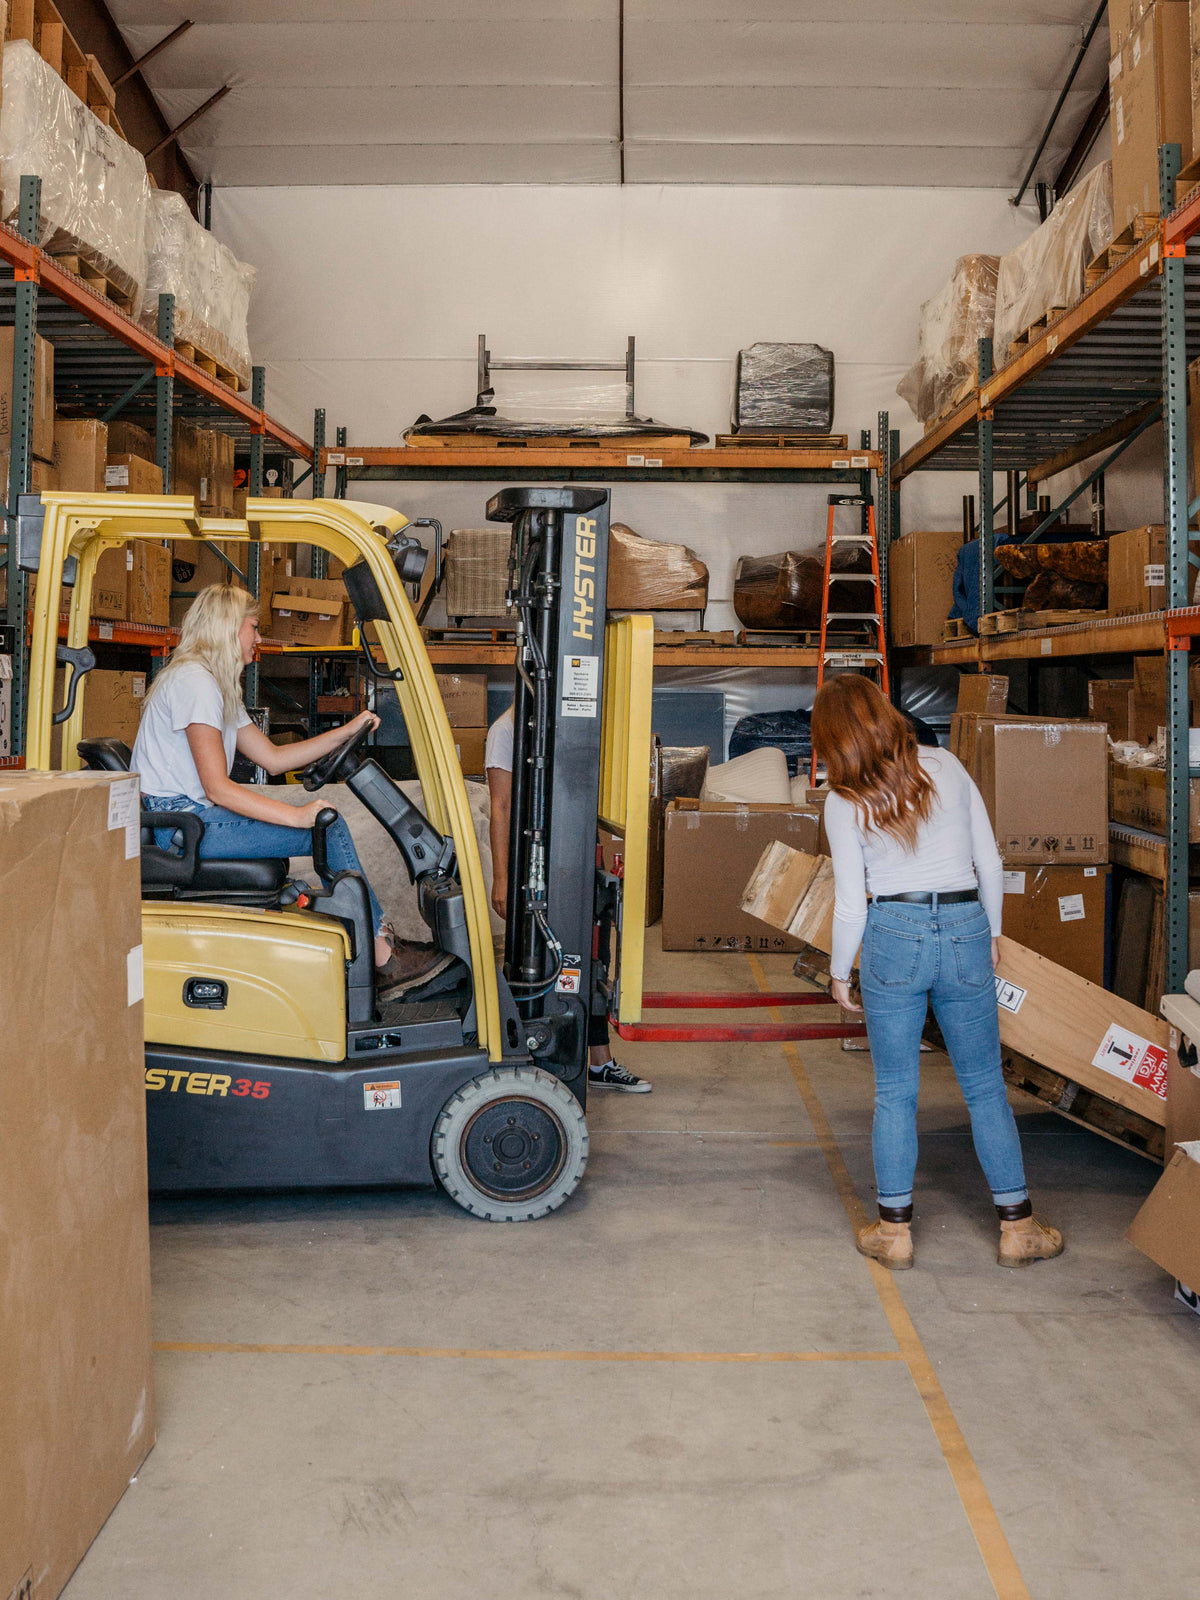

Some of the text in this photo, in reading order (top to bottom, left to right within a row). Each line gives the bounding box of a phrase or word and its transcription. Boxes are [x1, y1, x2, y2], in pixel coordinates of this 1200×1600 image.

[572, 516, 597, 640] HYSTER
[1066, 836, 1072, 845] 4
[745, 935, 751, 945] 3
[1140, 1057, 1152, 1076] KG
[145, 1068, 271, 1099] STER 35
